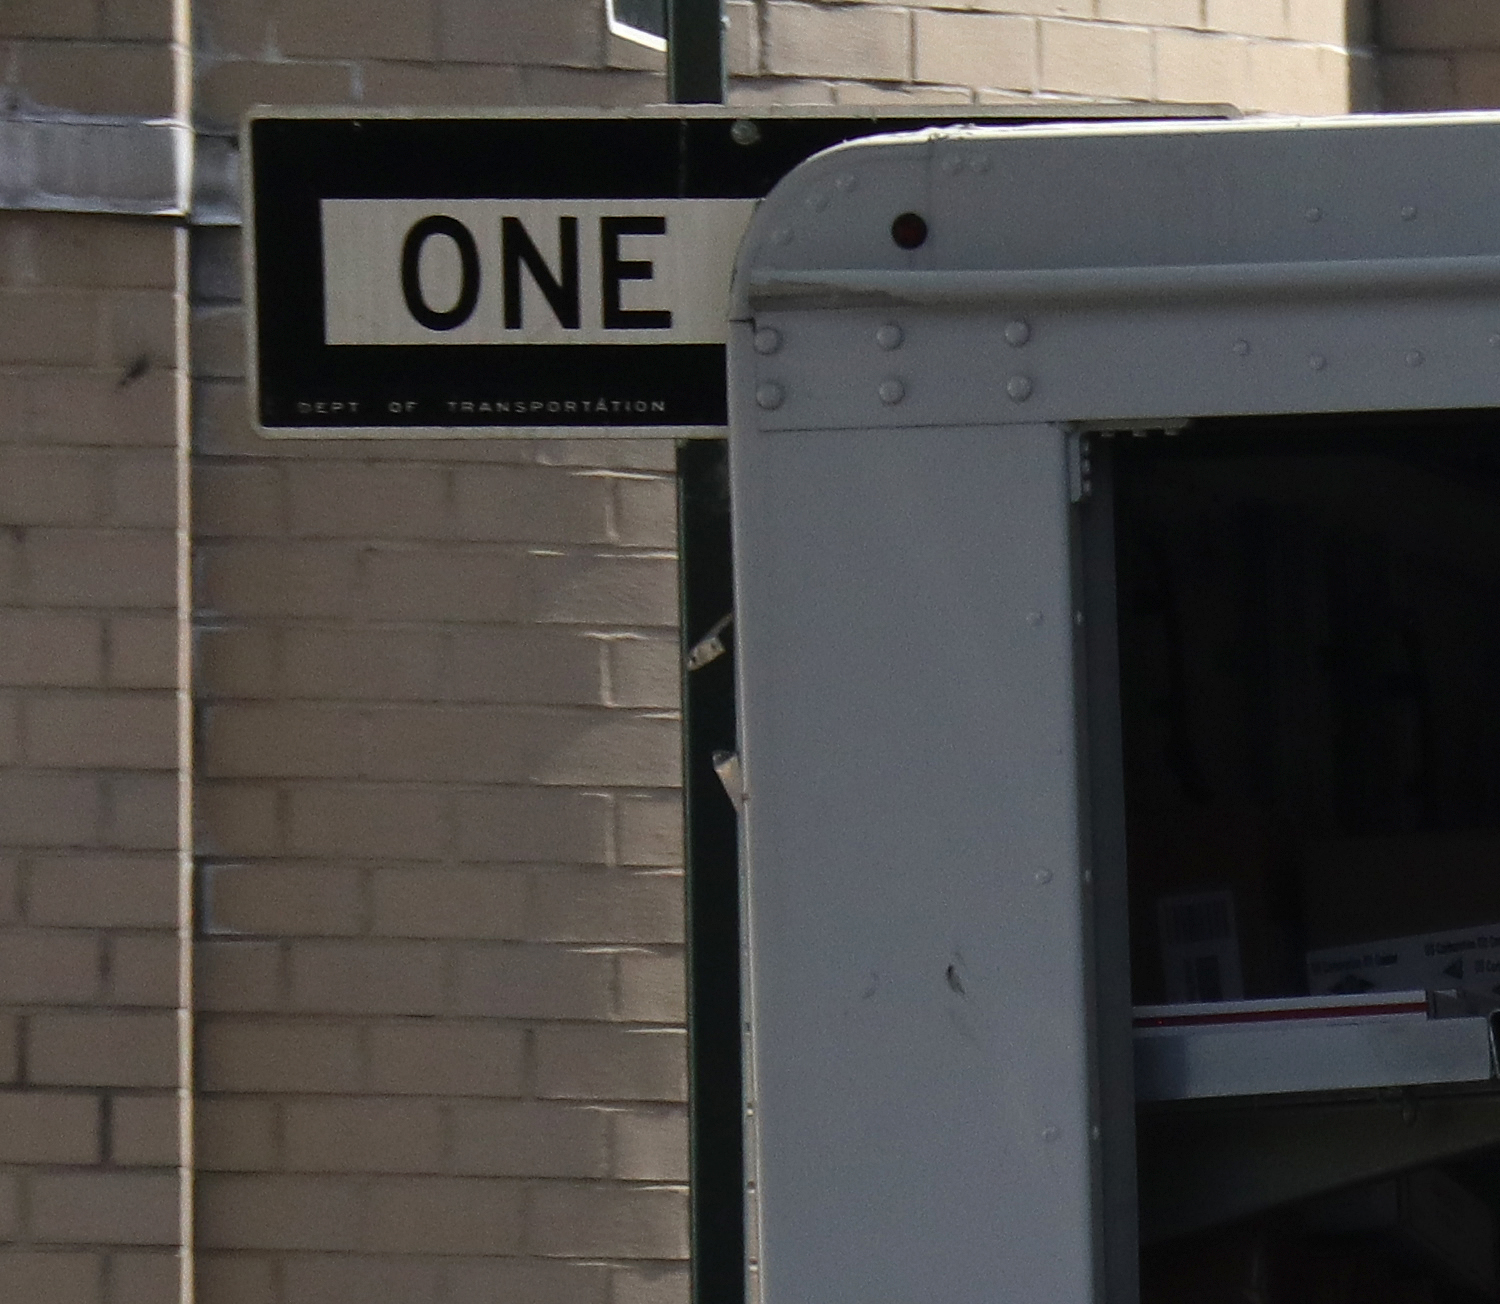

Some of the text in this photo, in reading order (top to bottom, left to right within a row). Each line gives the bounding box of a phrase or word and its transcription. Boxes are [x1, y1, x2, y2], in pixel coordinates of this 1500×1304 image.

[401, 214, 672, 331] ONE
[298, 400, 665, 413] DEPT OF TRANSPORTATION
